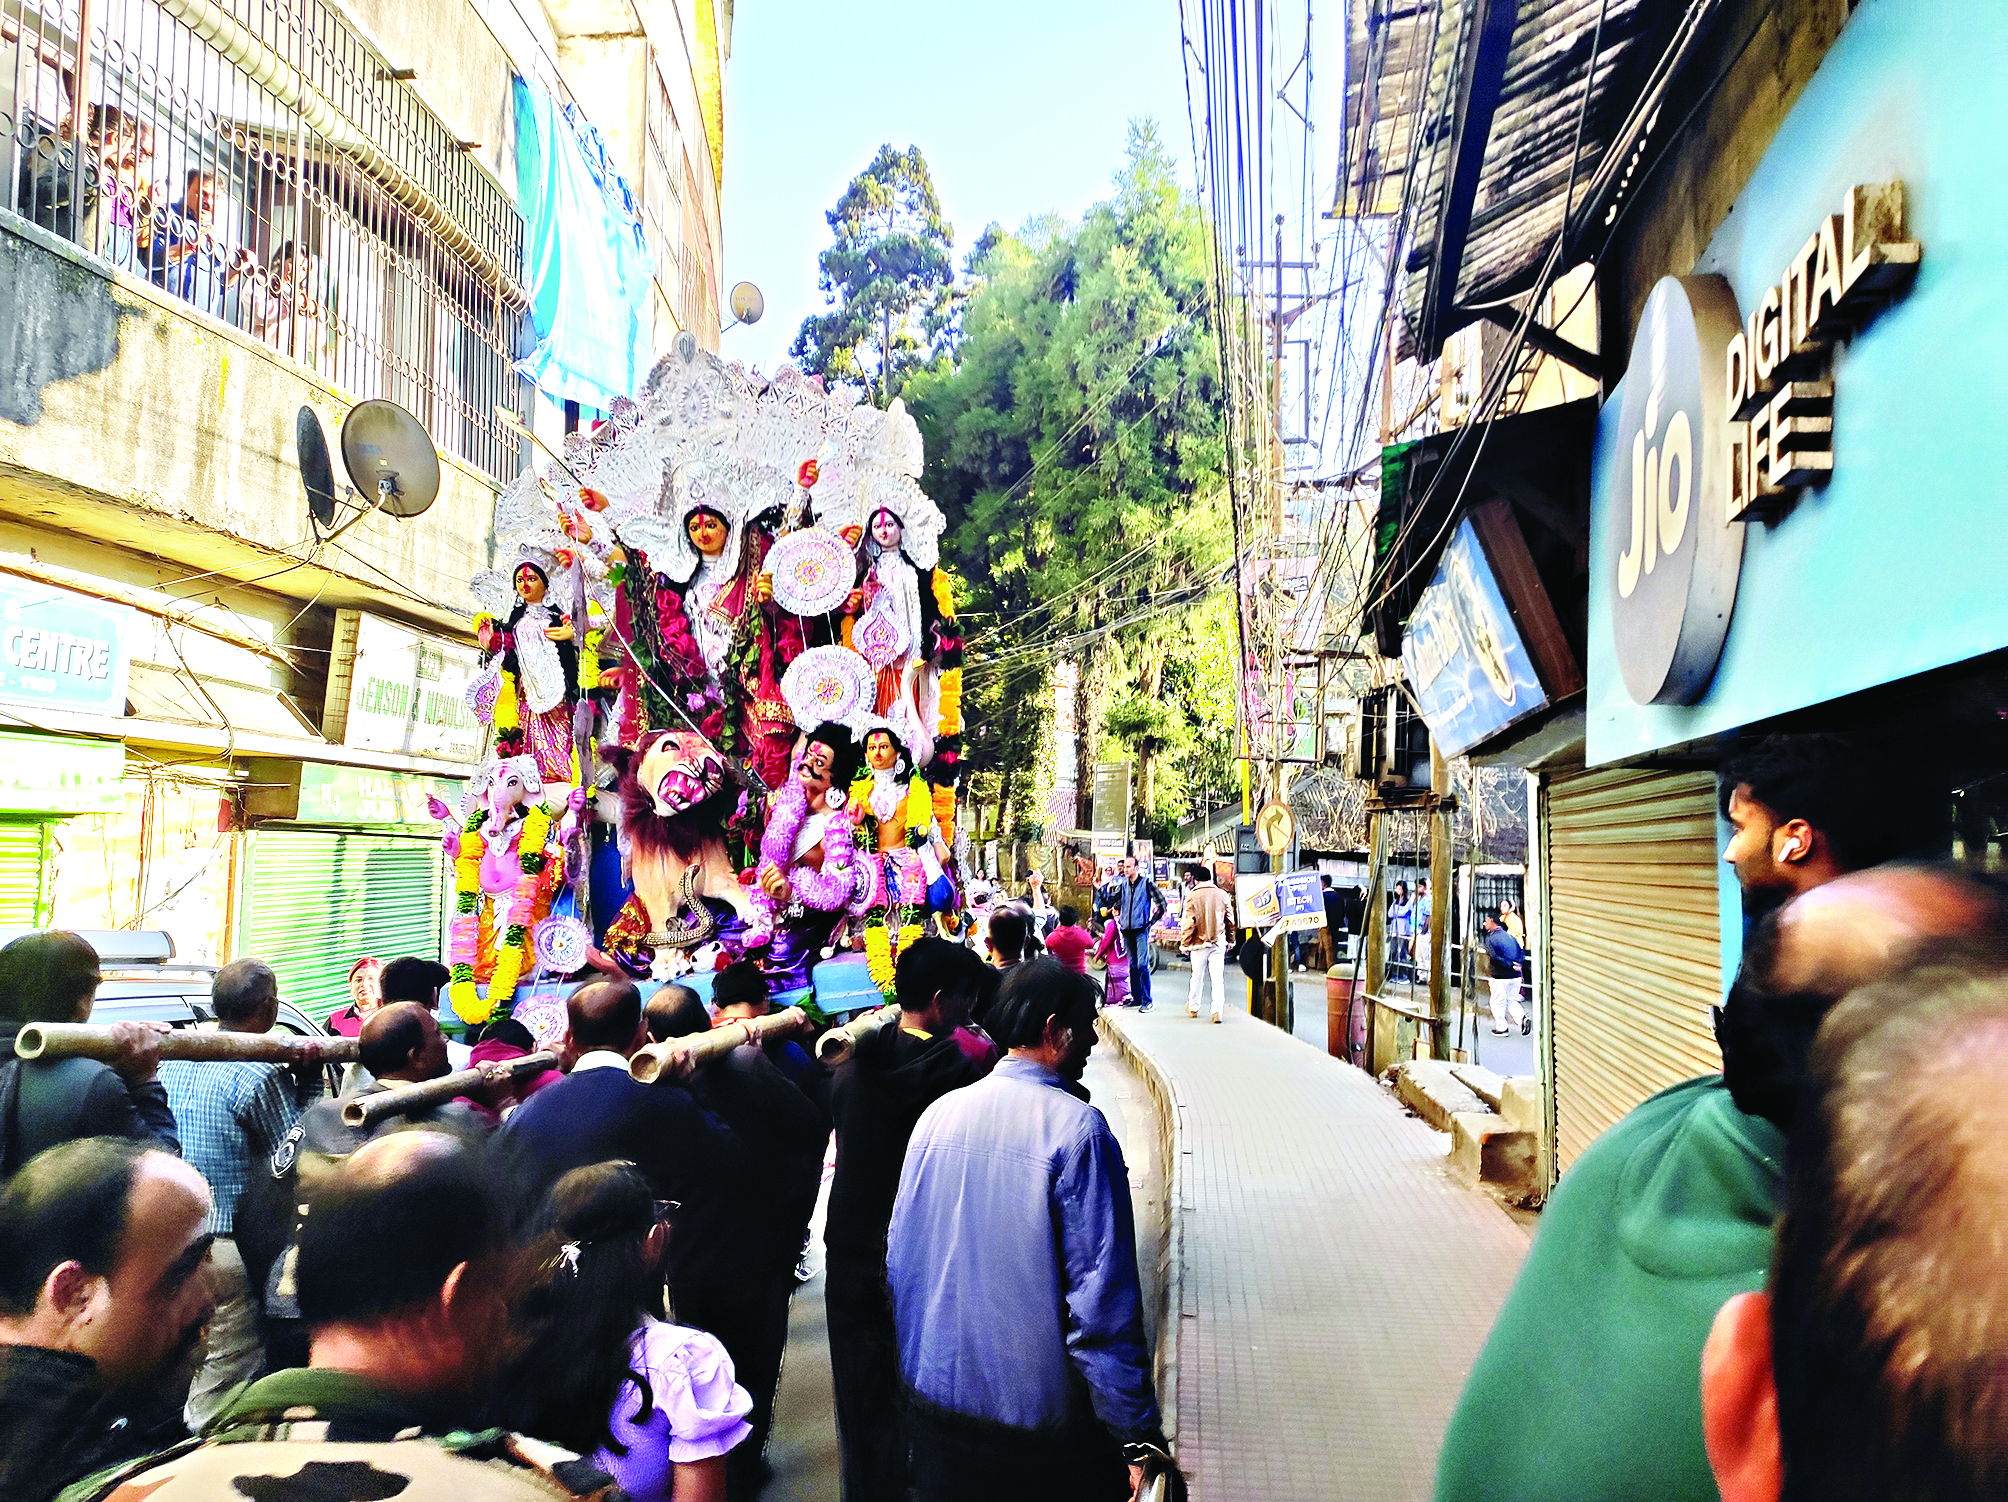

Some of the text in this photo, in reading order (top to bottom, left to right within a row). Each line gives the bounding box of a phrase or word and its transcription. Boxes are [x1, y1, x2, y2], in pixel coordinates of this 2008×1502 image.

[1727, 183, 1884, 422] DIGITAL
[1727, 382, 1802, 525] LIFE
[4, 625, 110, 681] CENTRE
[356, 677, 409, 719] JENSON
